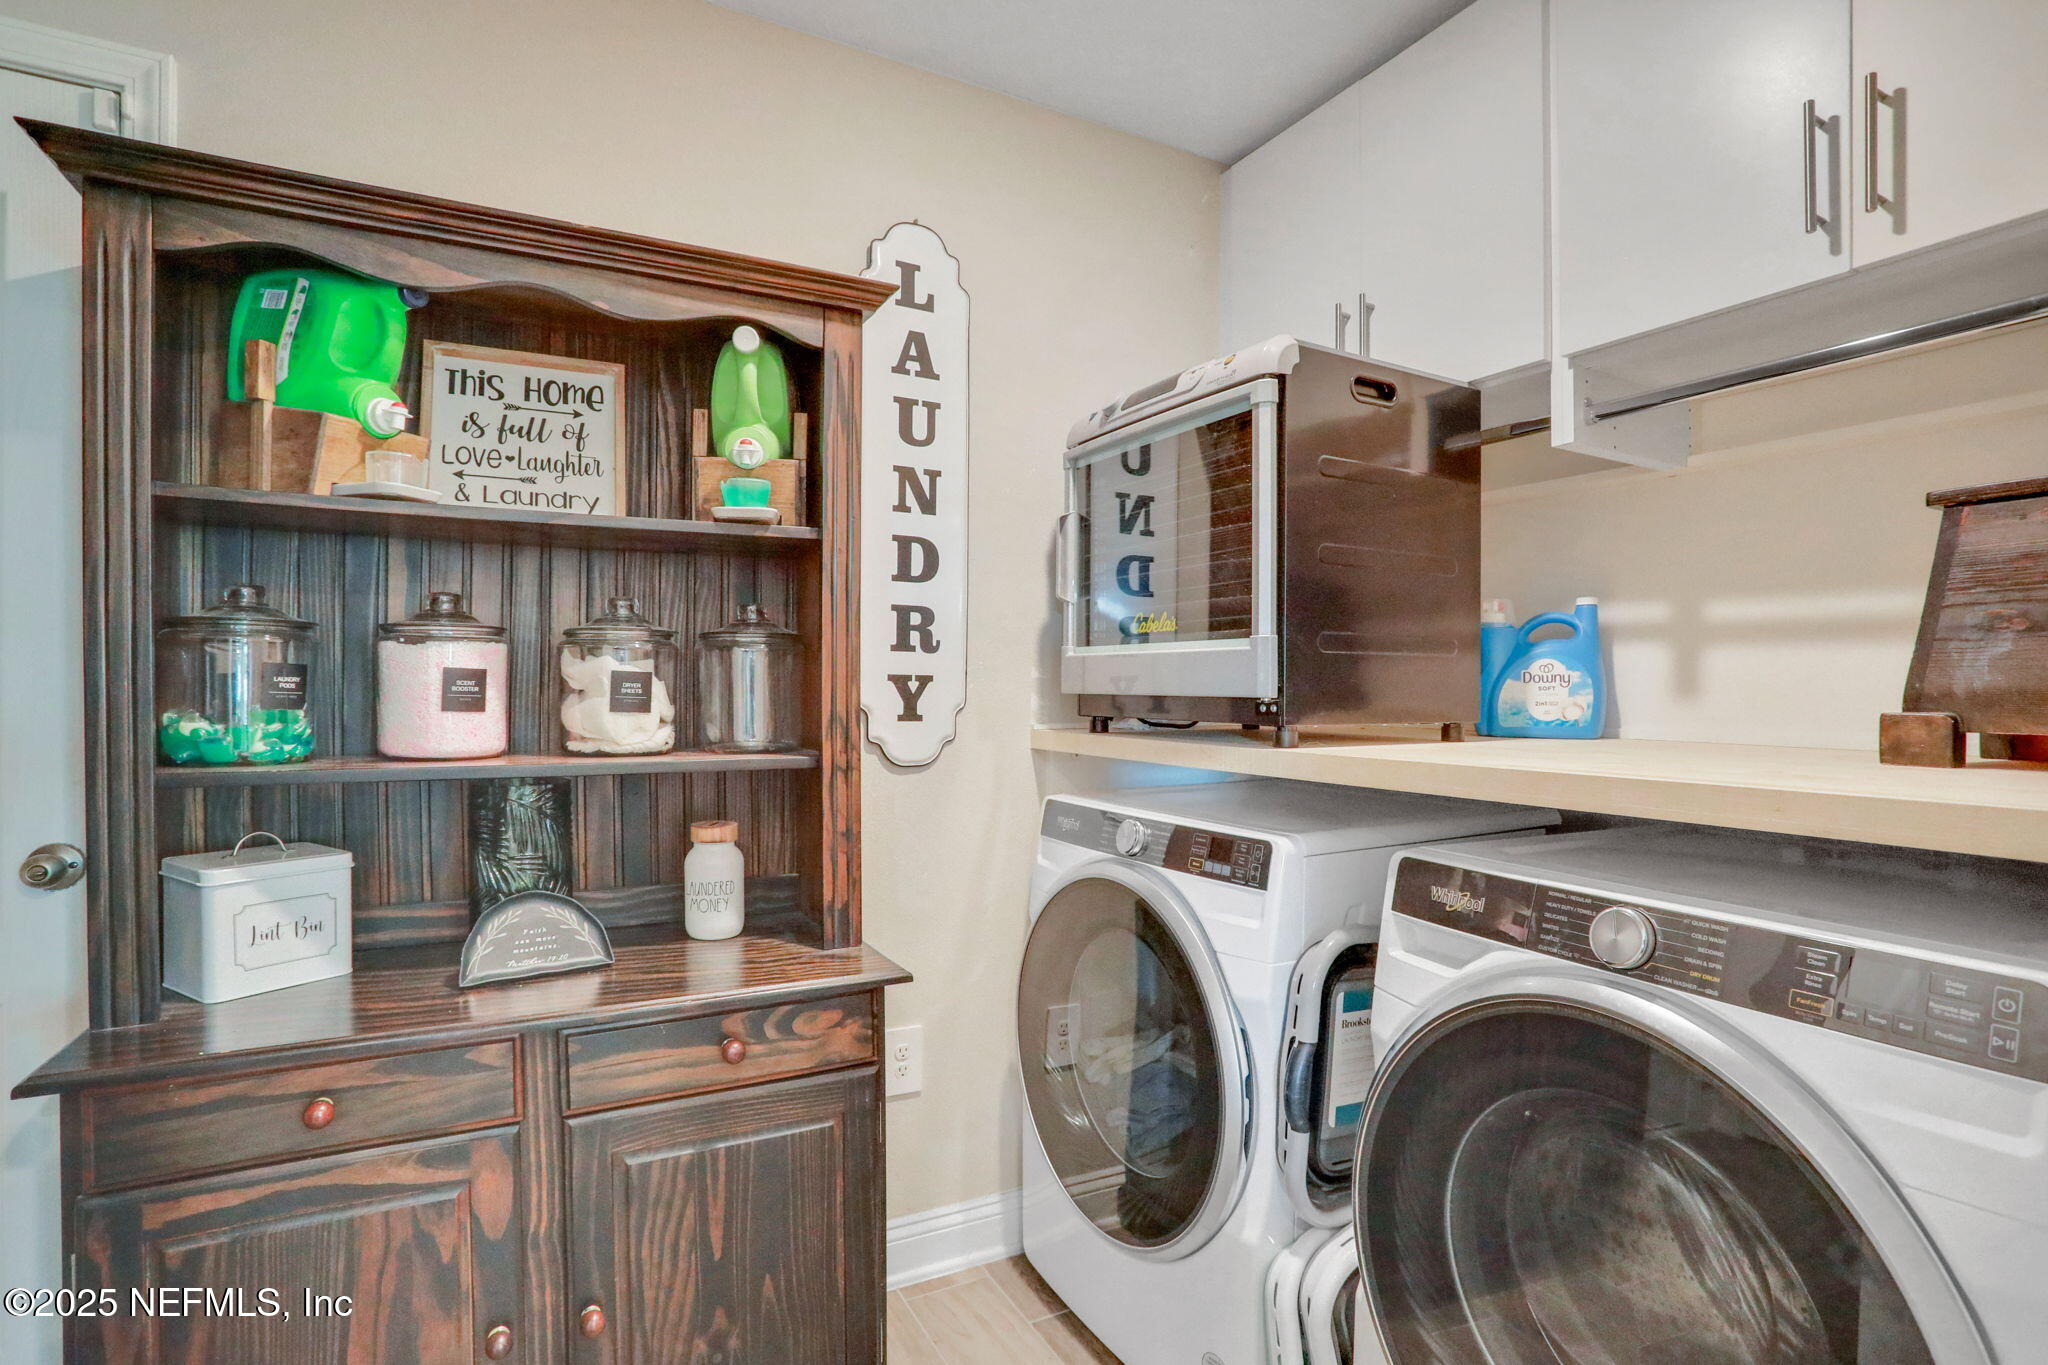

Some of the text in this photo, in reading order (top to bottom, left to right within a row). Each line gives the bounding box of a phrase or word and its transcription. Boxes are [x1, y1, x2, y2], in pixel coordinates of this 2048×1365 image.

[444, 368, 604, 412] This Home
[461, 411, 590, 452] is full of
[517, 446, 604, 484] Laughter
[454, 482, 600, 515] & Laundry
[887, 260, 942, 722] LAUNDRY
[1522, 671, 1571, 688] Downy
[689, 897, 729, 914] MONEY
[1431, 885, 1485, 917] Whirlpool
[295, 915, 324, 940] Bin
[1691, 919, 1729, 933] QUICK WASH
[1691, 932, 1727, 945] COLD WASH
[1697, 946, 1725, 958] BEDDING
[1684, 956, 1703, 966] DRAIN
[1708, 961, 1723, 971] SPIN
[1653, 974, 1698, 991] CLEAN WASHER
